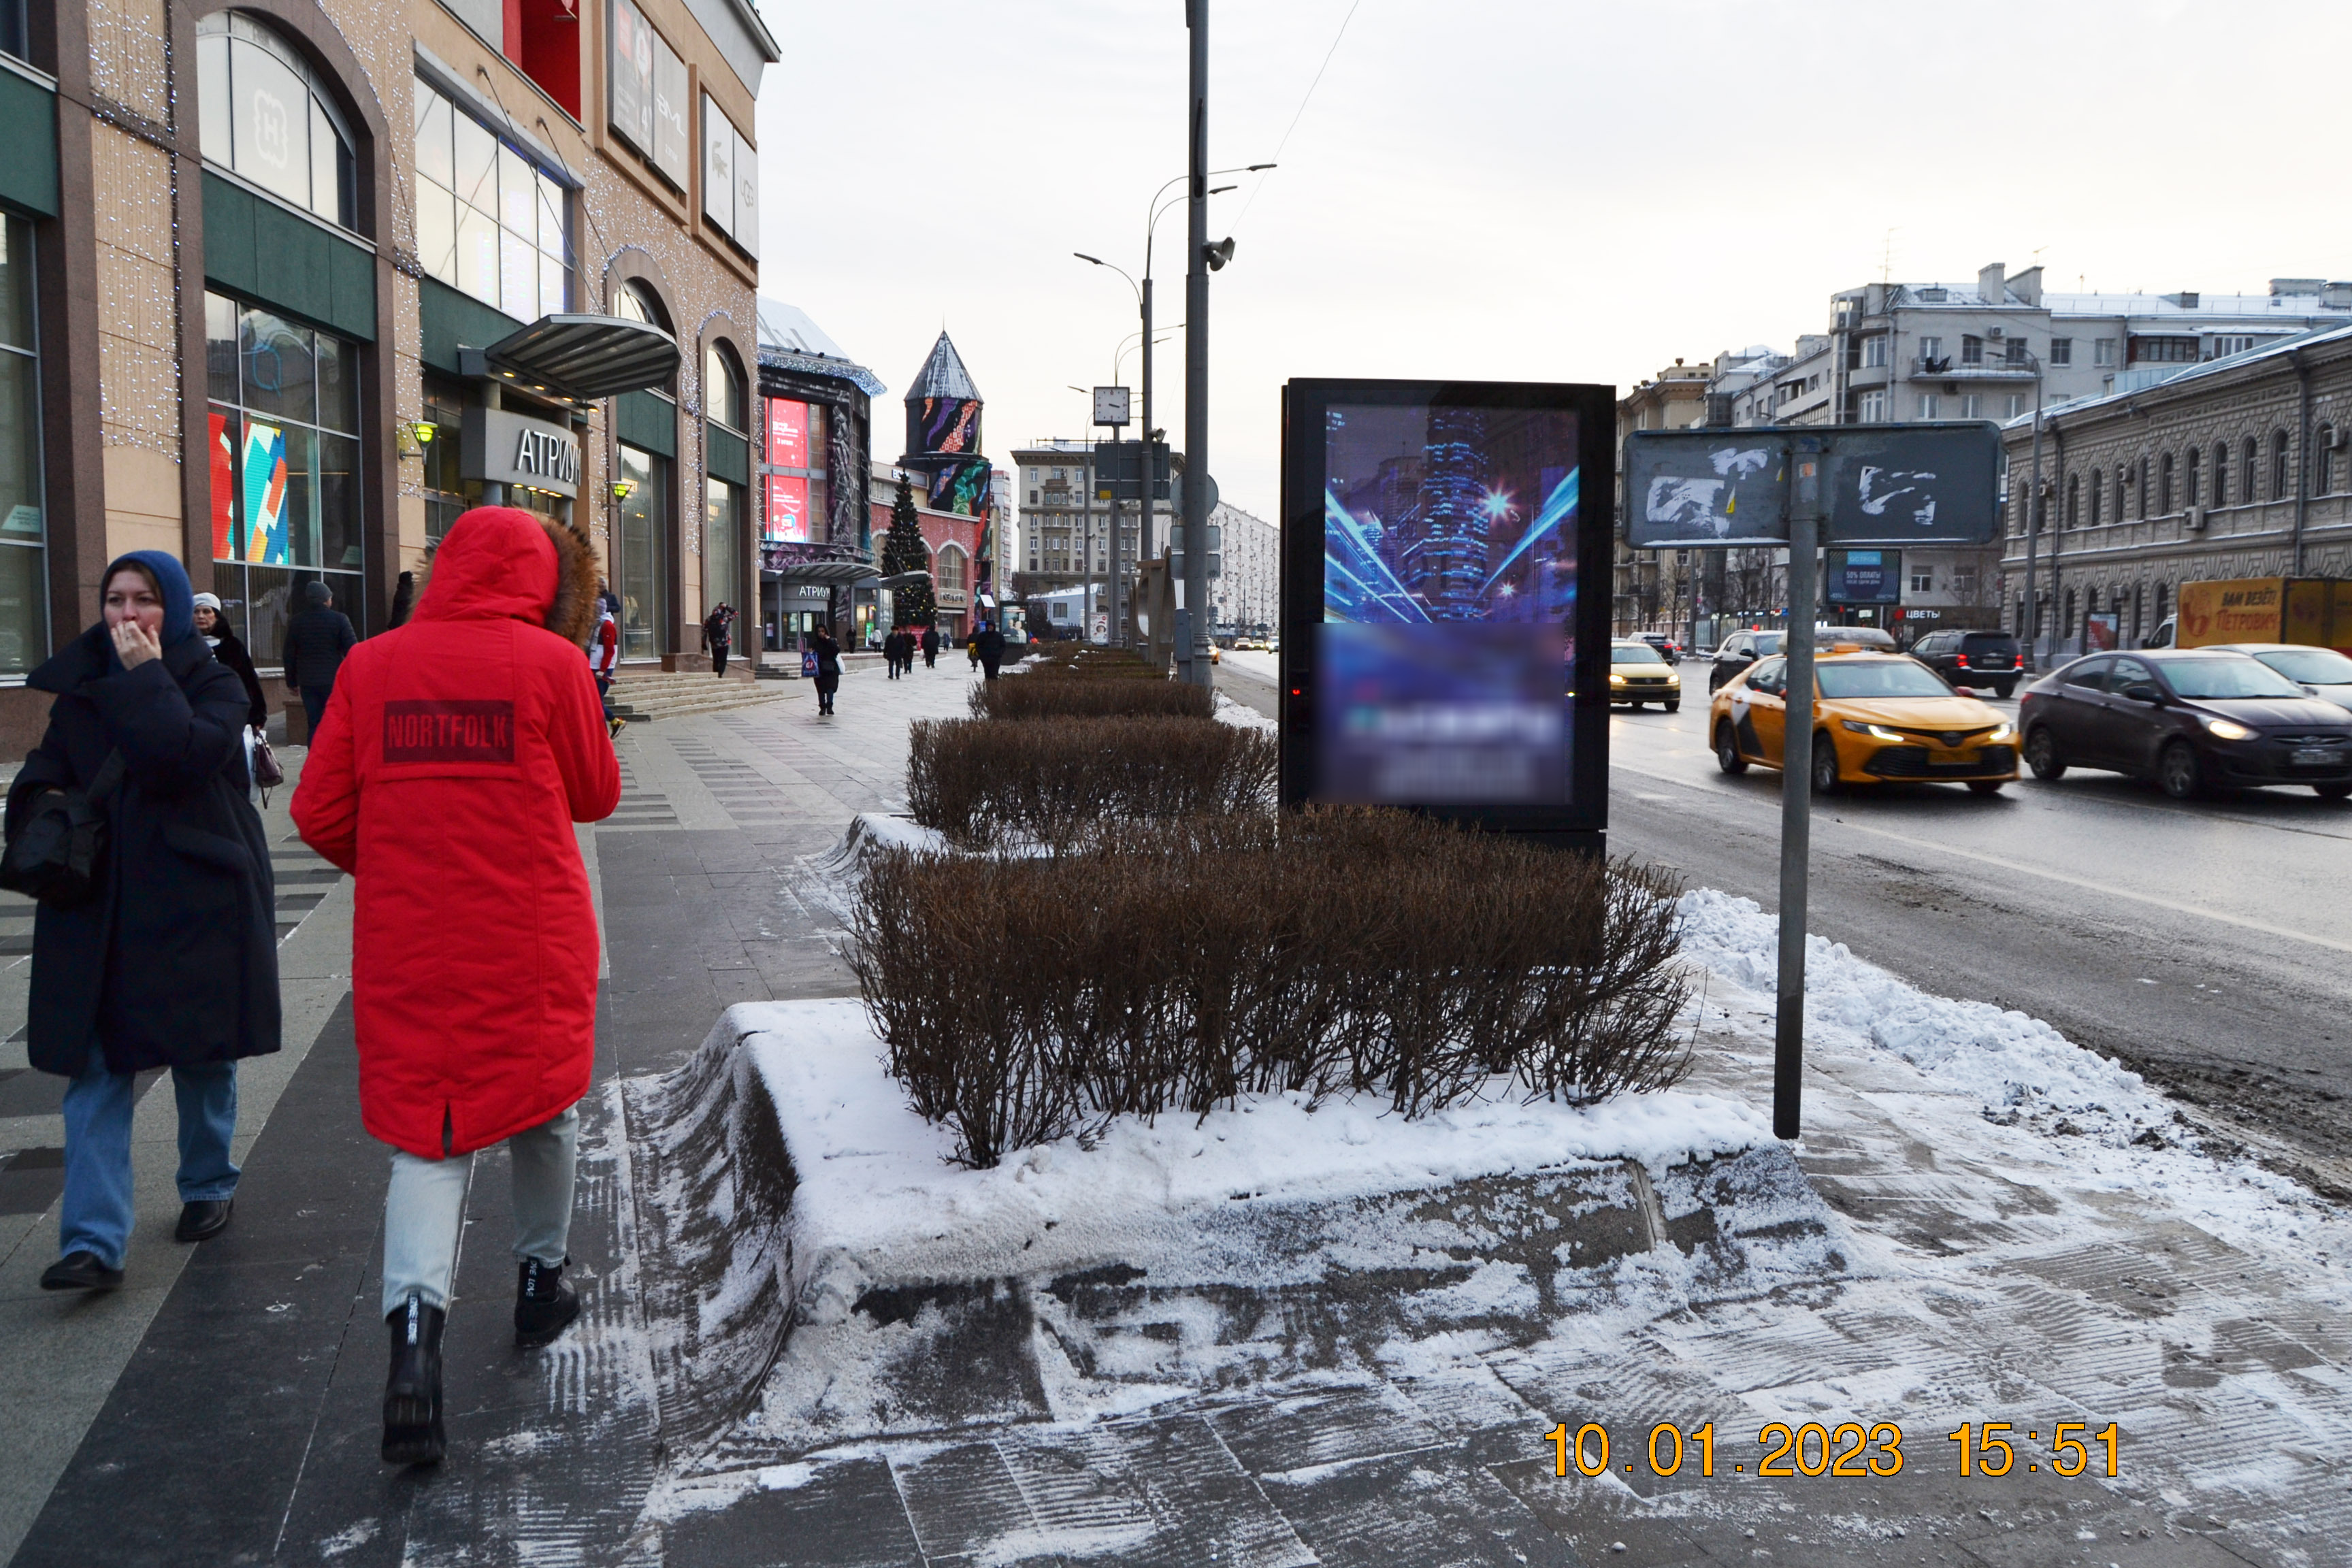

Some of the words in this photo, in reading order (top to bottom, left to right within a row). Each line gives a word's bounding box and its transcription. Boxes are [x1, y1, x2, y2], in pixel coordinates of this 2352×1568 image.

[740, 174, 754, 208] UGG
[1906, 610, 1940, 619] ЦВЕТЫ
[388, 715, 507, 747] NORTFOLK
